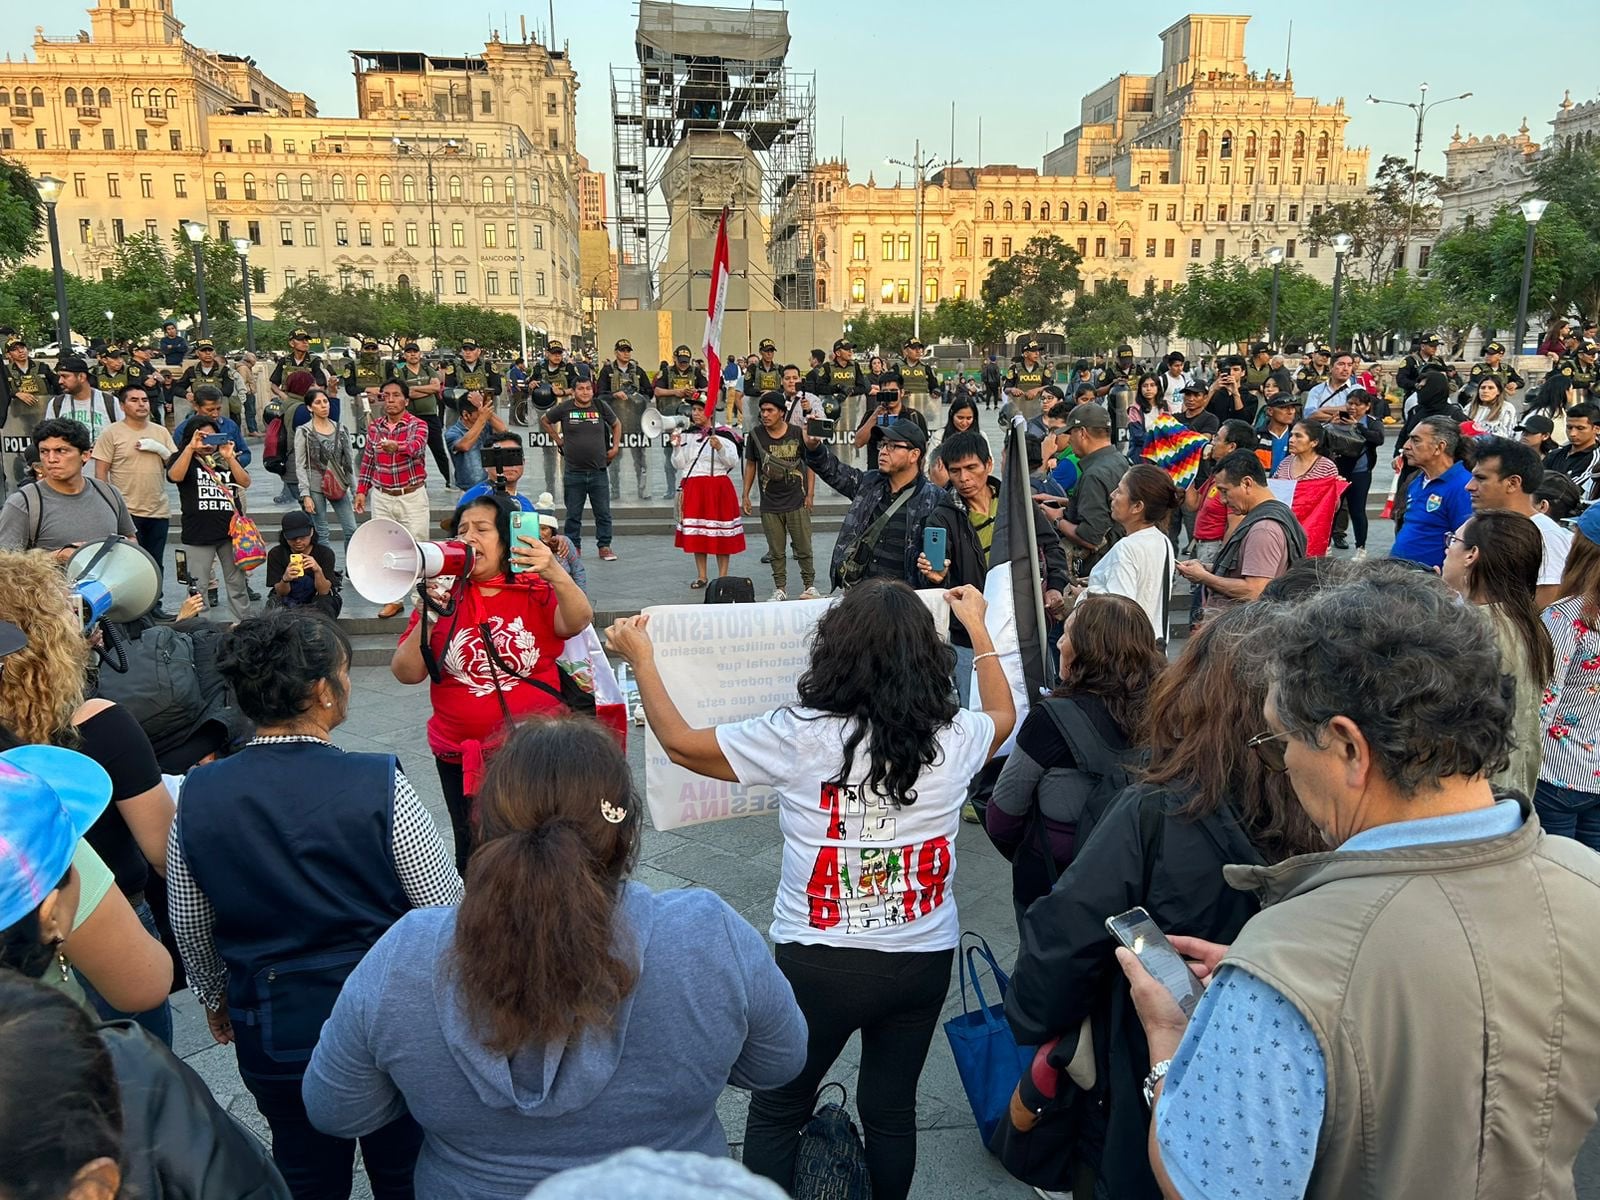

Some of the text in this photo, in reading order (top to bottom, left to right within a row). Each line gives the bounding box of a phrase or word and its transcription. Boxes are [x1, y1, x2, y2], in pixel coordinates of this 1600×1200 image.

[1020, 374, 1041, 382] POLICIA
[827, 431, 856, 444] OLIC
[4, 436, 31, 452] POLI
[199, 500, 209, 510] ES
[210, 500, 219, 510] EL
